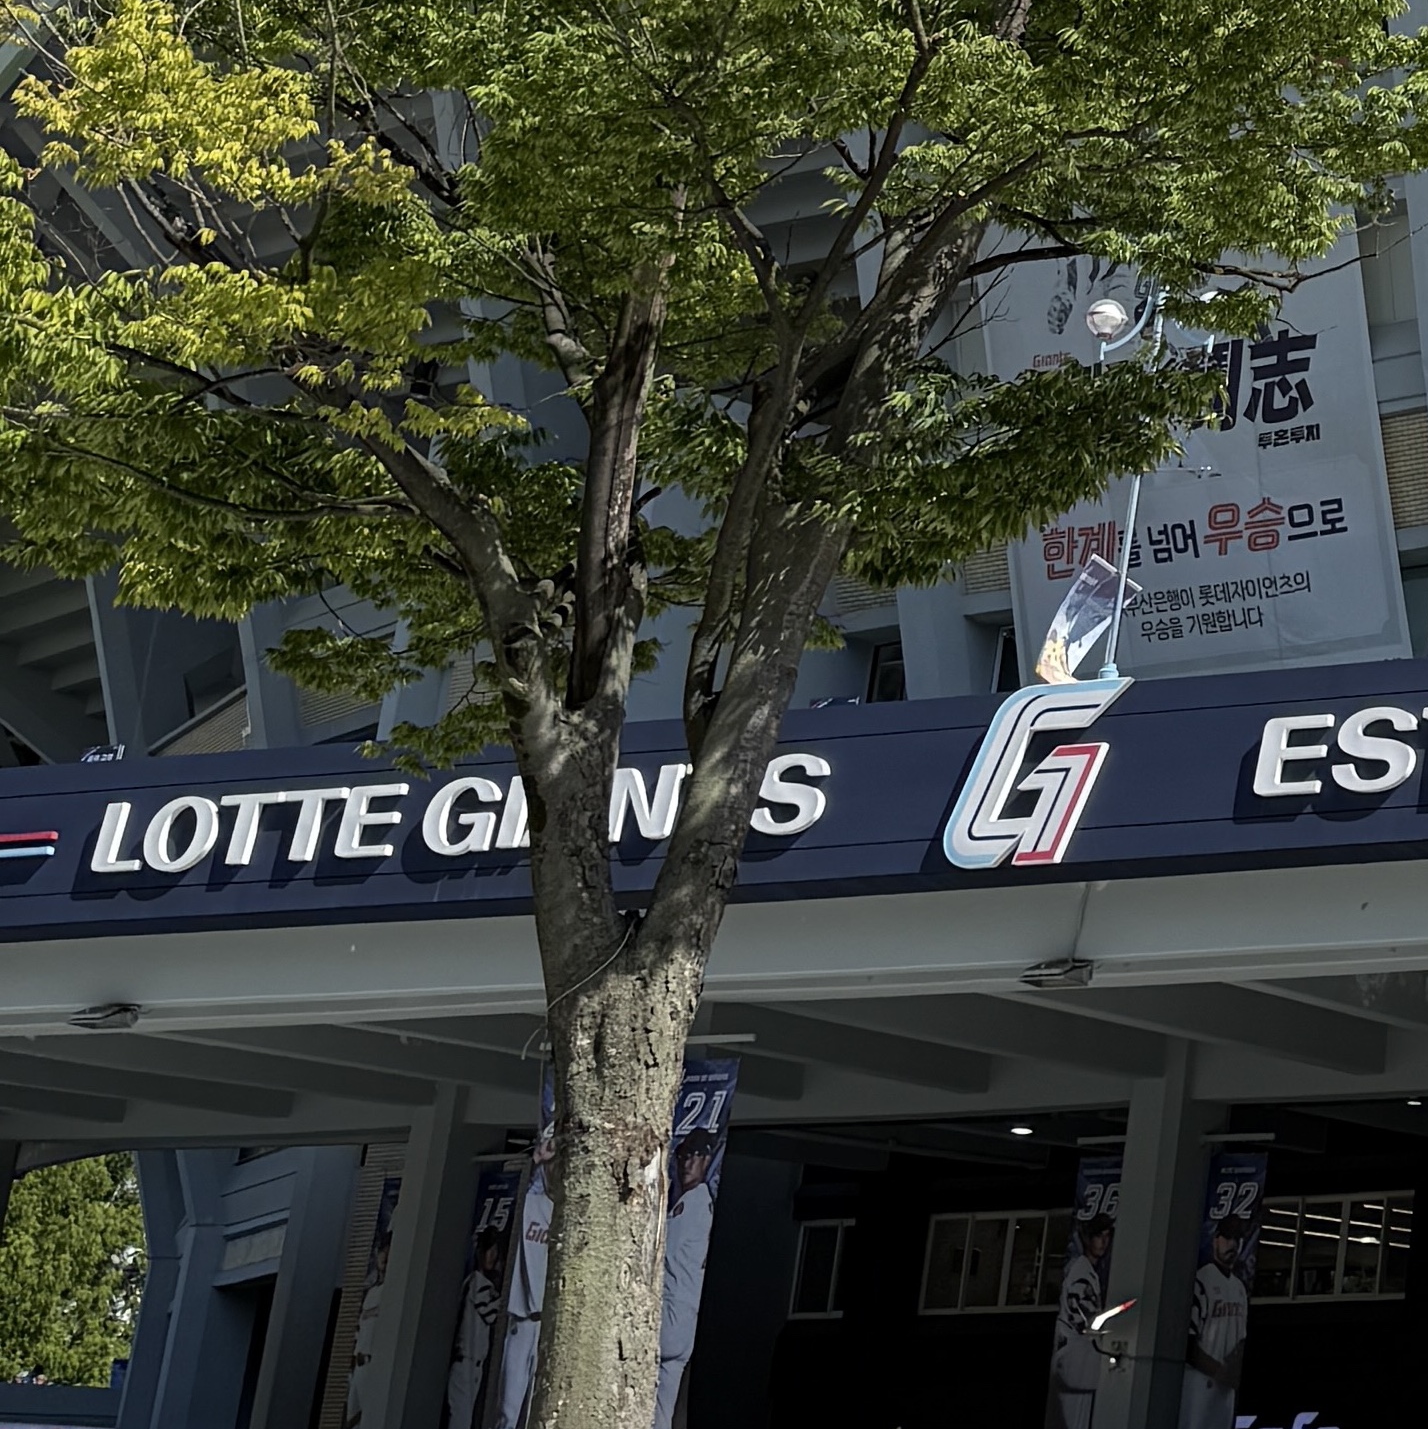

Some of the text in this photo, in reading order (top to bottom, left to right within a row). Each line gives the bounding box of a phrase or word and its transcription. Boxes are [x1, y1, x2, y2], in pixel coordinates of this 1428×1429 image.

[1147, 519, 1201, 565] 넘어
[1203, 496, 1349, 557] 우승으로
[1198, 570, 1313, 608] 롯데자이언츠의
[1141, 605, 1265, 644] 우승을 기원합니다
[90, 750, 833, 875] LOTTE GINS
[674, 1089, 728, 1135] 21
[474, 1197, 515, 1232] 15
[1209, 1181, 1259, 1220] 32
